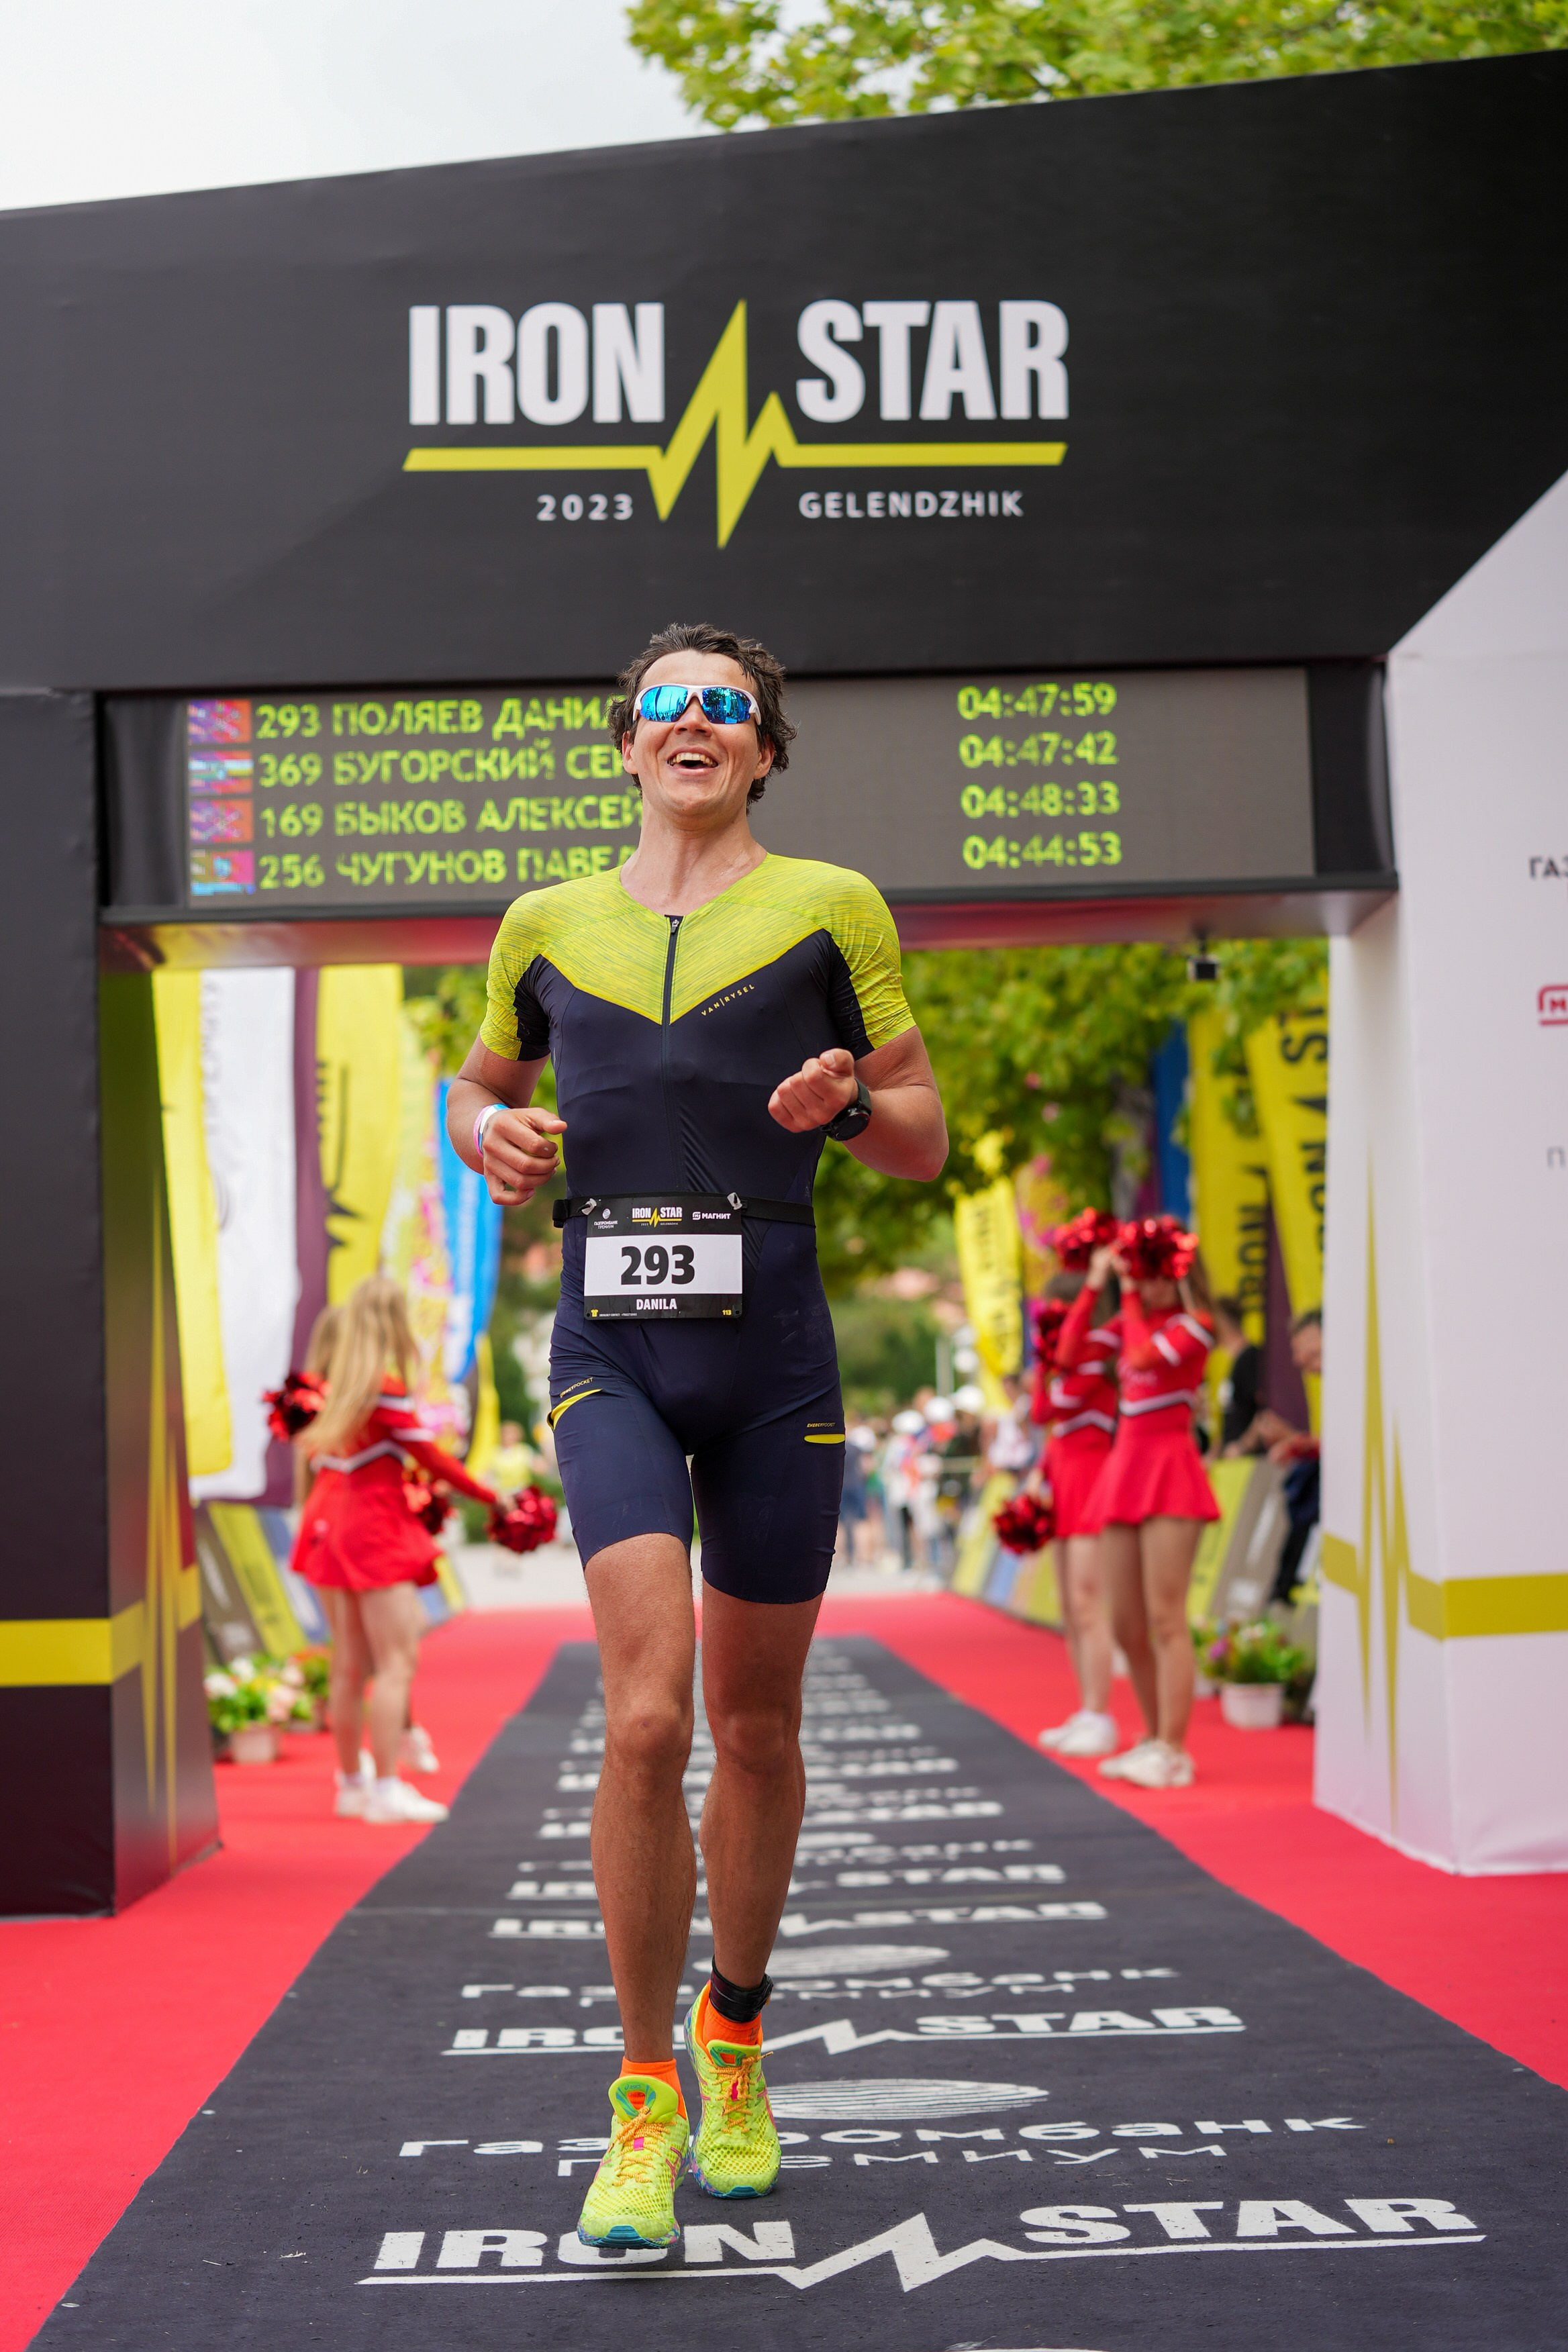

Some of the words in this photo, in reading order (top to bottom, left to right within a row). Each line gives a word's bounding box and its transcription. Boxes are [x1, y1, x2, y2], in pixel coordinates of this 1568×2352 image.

[409, 302, 665, 426] IRON
[796, 299, 1068, 423] STAR
[536, 493, 634, 521] 2023
[798, 491, 1023, 519] GELENDZHIK
[256, 703, 322, 739] 293
[332, 699, 484, 736] ПОЛЯЕВ
[957, 682, 1118, 720] 04:47:59
[259, 752, 323, 787] 369
[334, 738, 556, 786] БУГОРСКИЙ
[959, 730, 1119, 768] 04:47:42
[260, 803, 323, 837] 169
[334, 799, 467, 836] БЫКОВ
[961, 780, 1121, 819] 04:48:33
[259, 852, 326, 889] 256
[336, 848, 507, 886] ЧУГУНОВ
[963, 830, 1123, 870] 04:44:53
[632, 1208, 651, 1219] IRON
[660, 1207, 683, 1218] STAR
[620, 1244, 696, 1286] 293
[636, 1298, 678, 1310] DANILA
[916, 2006, 1243, 2035] STAR
[1020, 2197, 1477, 2245] STAR
